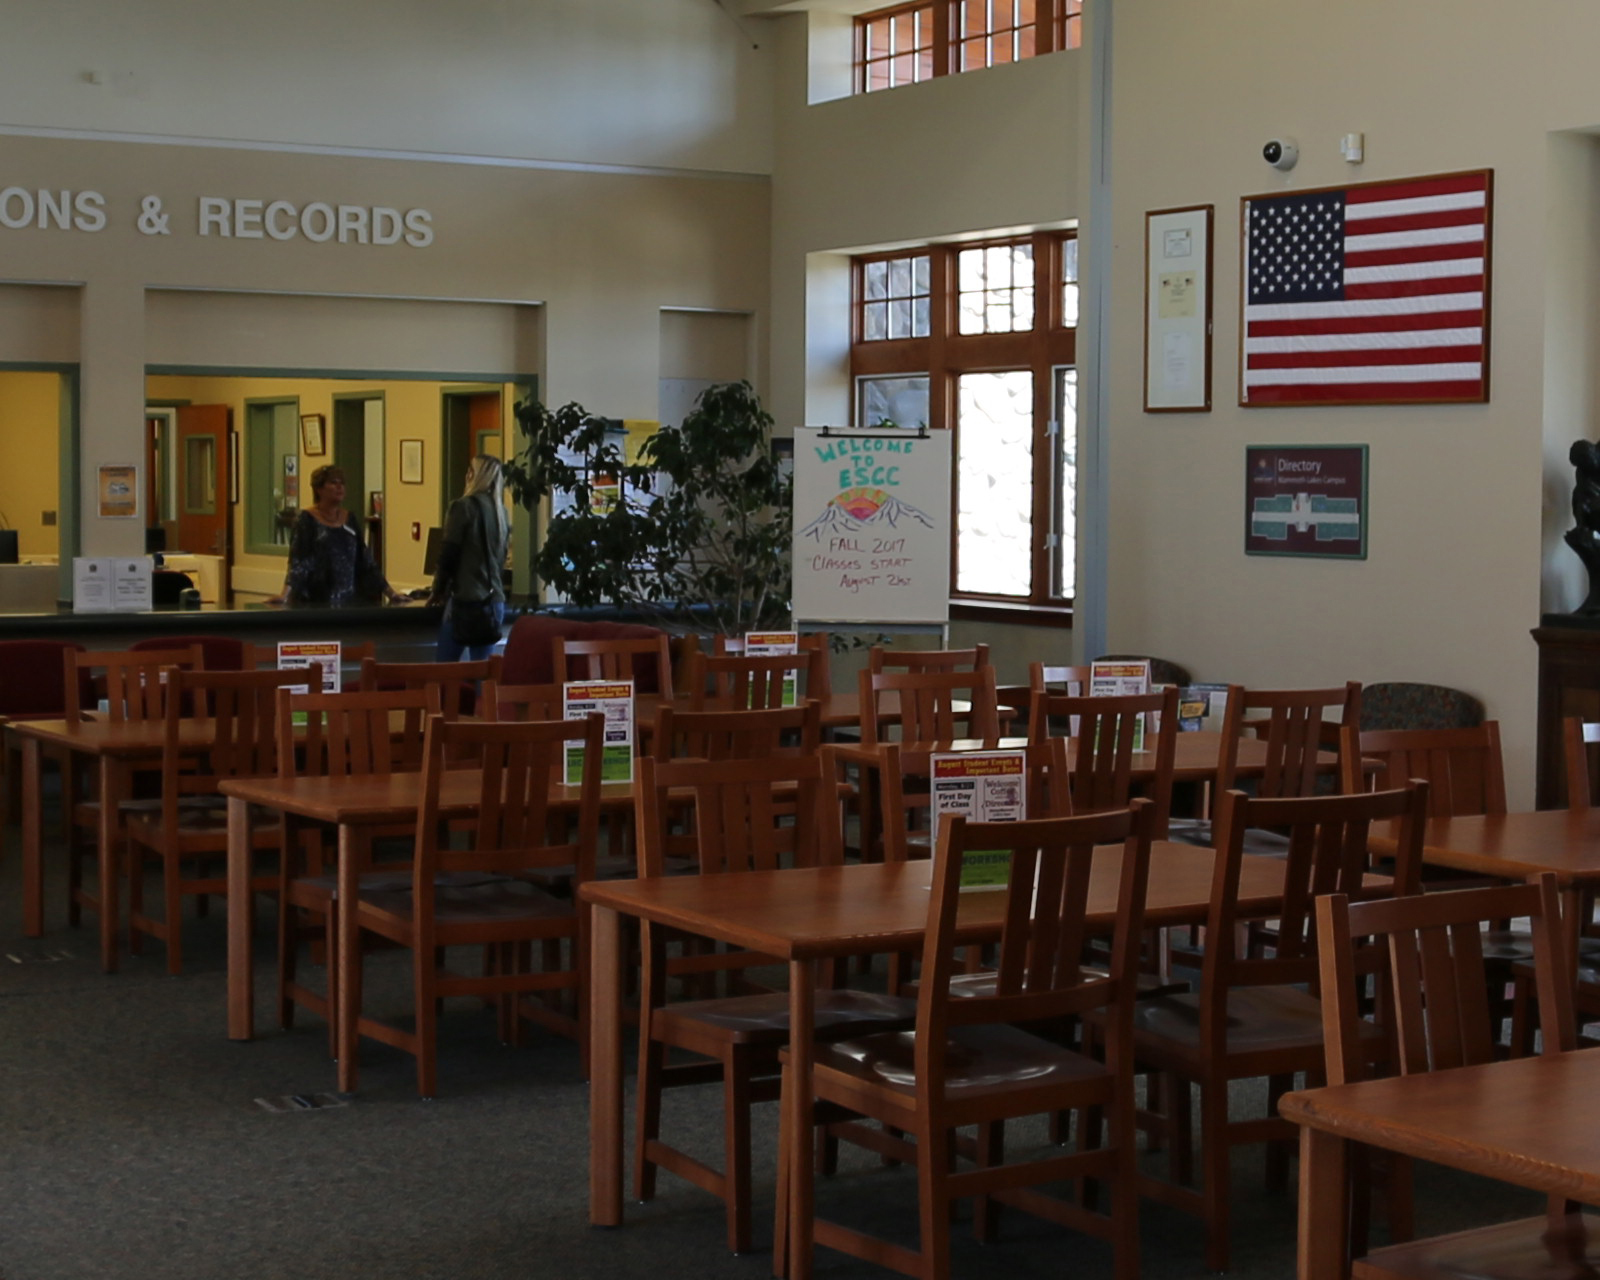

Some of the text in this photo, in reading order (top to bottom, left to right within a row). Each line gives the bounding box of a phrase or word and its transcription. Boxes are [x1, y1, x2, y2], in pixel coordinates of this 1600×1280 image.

[136, 195, 171, 236] &
[197, 196, 434, 248] RECORDS
[814, 438, 913, 463] WELCOME
[850, 455, 875, 468] TO
[1278, 458, 1322, 474] Directory
[839, 467, 900, 489] ESCC
[829, 537, 906, 554] FALL 2017
[939, 792, 972, 801] First Day
